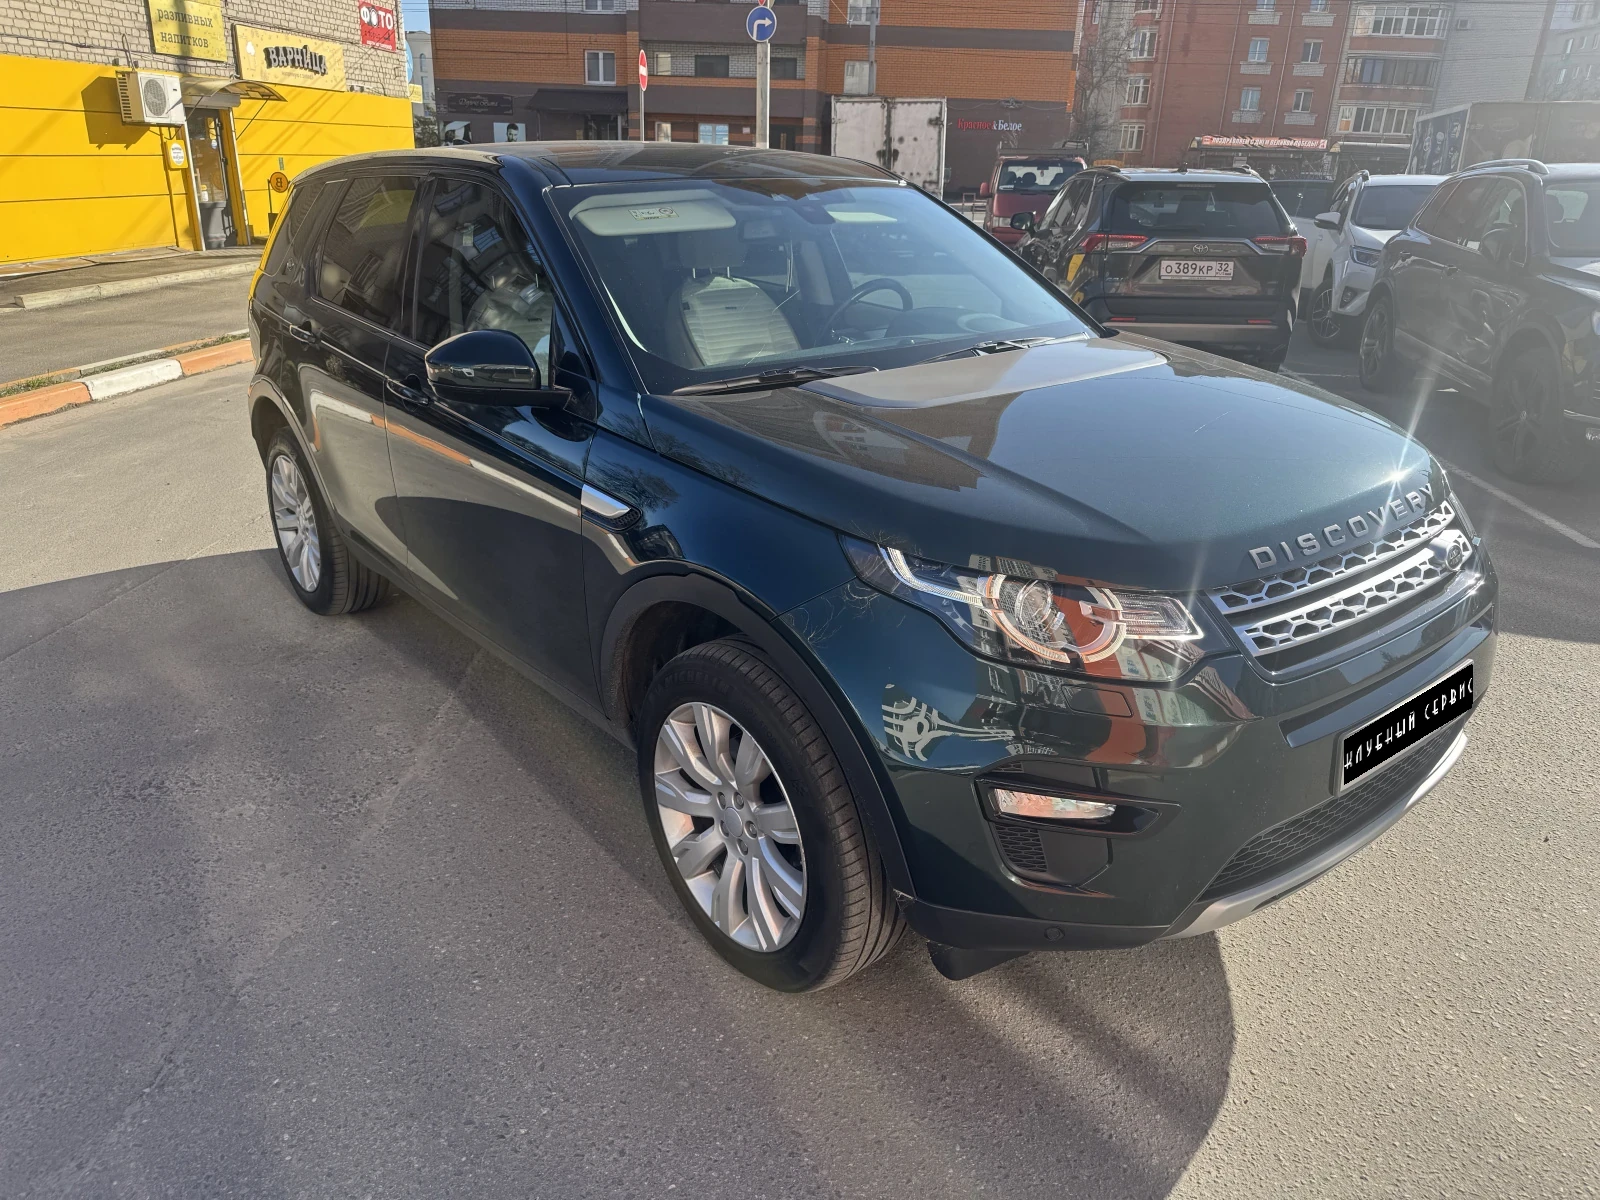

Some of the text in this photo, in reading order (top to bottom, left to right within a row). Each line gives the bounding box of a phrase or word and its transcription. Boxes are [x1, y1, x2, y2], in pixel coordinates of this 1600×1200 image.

[157, 8, 214, 28] разливных
[160, 32, 209, 48] напитков
[1217, 262, 1229, 272] 32
[1248, 483, 1435, 570] DISCOVERY
